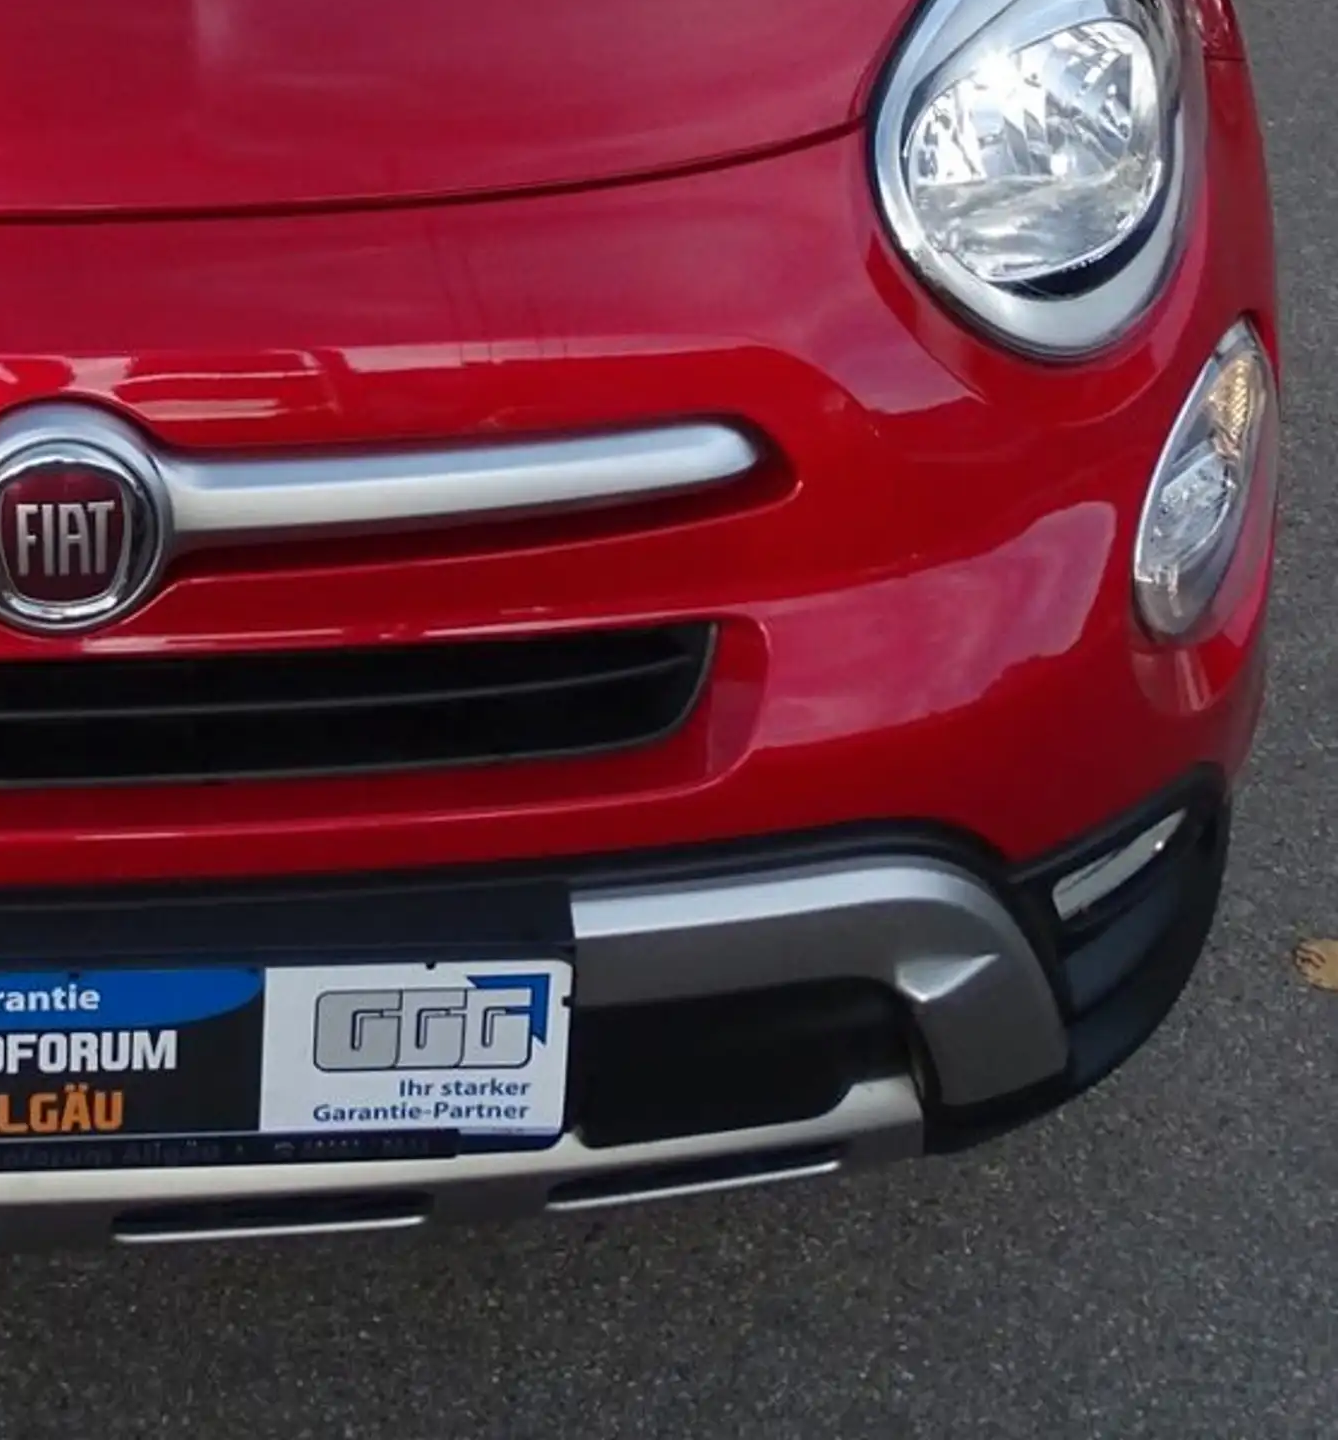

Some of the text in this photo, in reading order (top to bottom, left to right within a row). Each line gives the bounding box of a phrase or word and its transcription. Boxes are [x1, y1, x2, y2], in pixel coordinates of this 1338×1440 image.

[15, 500, 116, 577] FIAT
[399, 1077, 531, 1098] Ihr starker
[313, 1101, 530, 1123] Garantie-Partner
